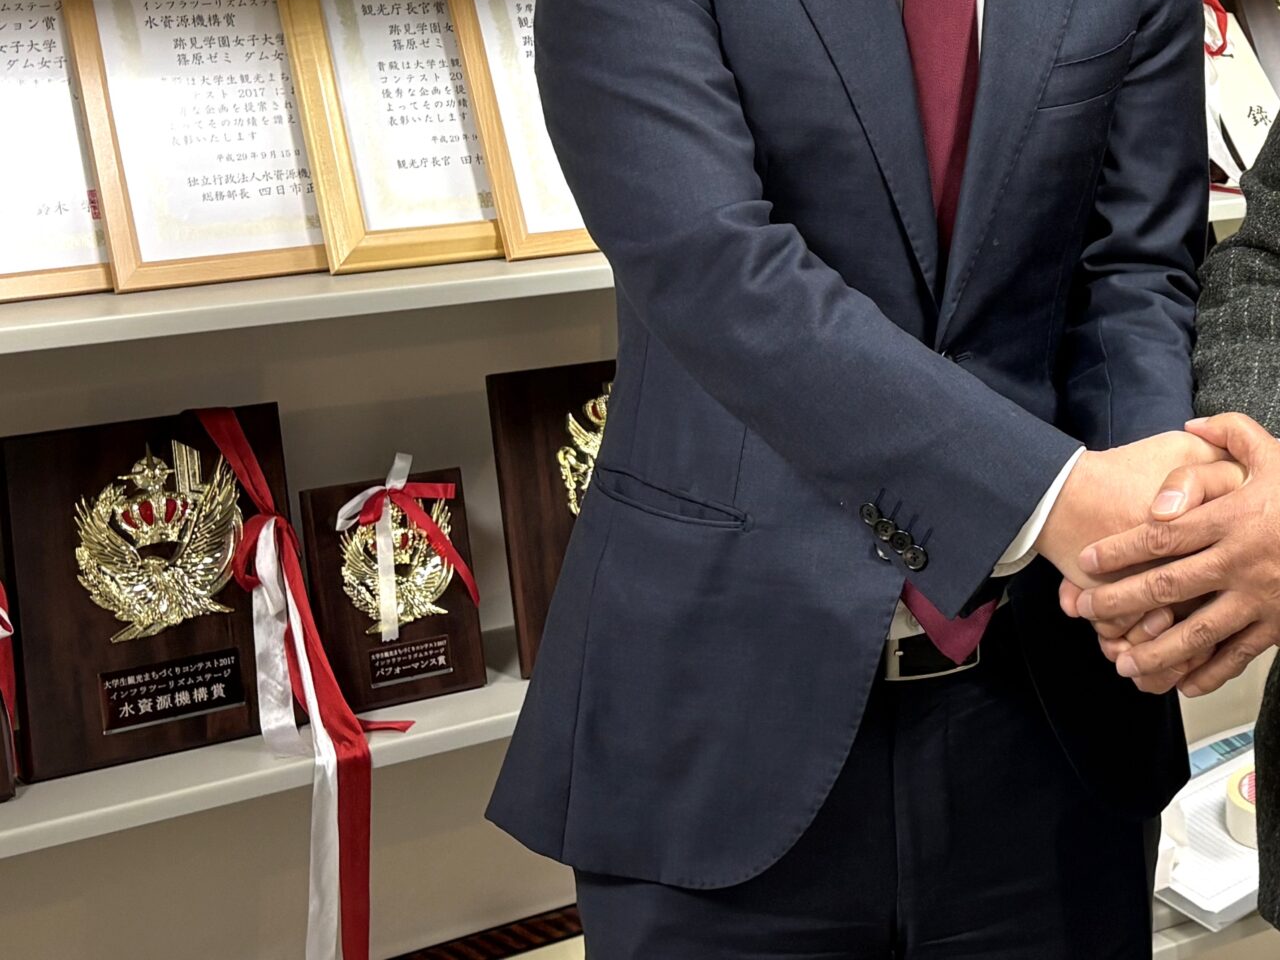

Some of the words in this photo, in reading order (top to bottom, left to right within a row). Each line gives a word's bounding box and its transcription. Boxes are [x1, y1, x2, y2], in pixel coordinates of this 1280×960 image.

[361, 1, 445, 16] 観光庁長官賞
[144, 13, 236, 30] 水資源機構賞
[517, 16, 533, 29] 観
[392, 38, 444, 52] 篠原ゼミ
[7, 55, 68, 71] ダム女子
[176, 51, 234, 66] 篠原ゼミ
[244, 50, 288, 63] ダム女
[160, 72, 291, 87] は大学生観光まち
[380, 72, 440, 85] コンテスト
[450, 71, 463, 82] 20
[238, 88, 266, 99] 2017
[389, 111, 468, 127] 表彰いたします
[104, 656, 235, 690] 大学生観光まちづくりコンテスト2017
[375, 655, 447, 677] パフォーマンス賞
[110, 669, 231, 701] インフラツーリズムステージ
[119, 683, 227, 718] 水資源機構賞
